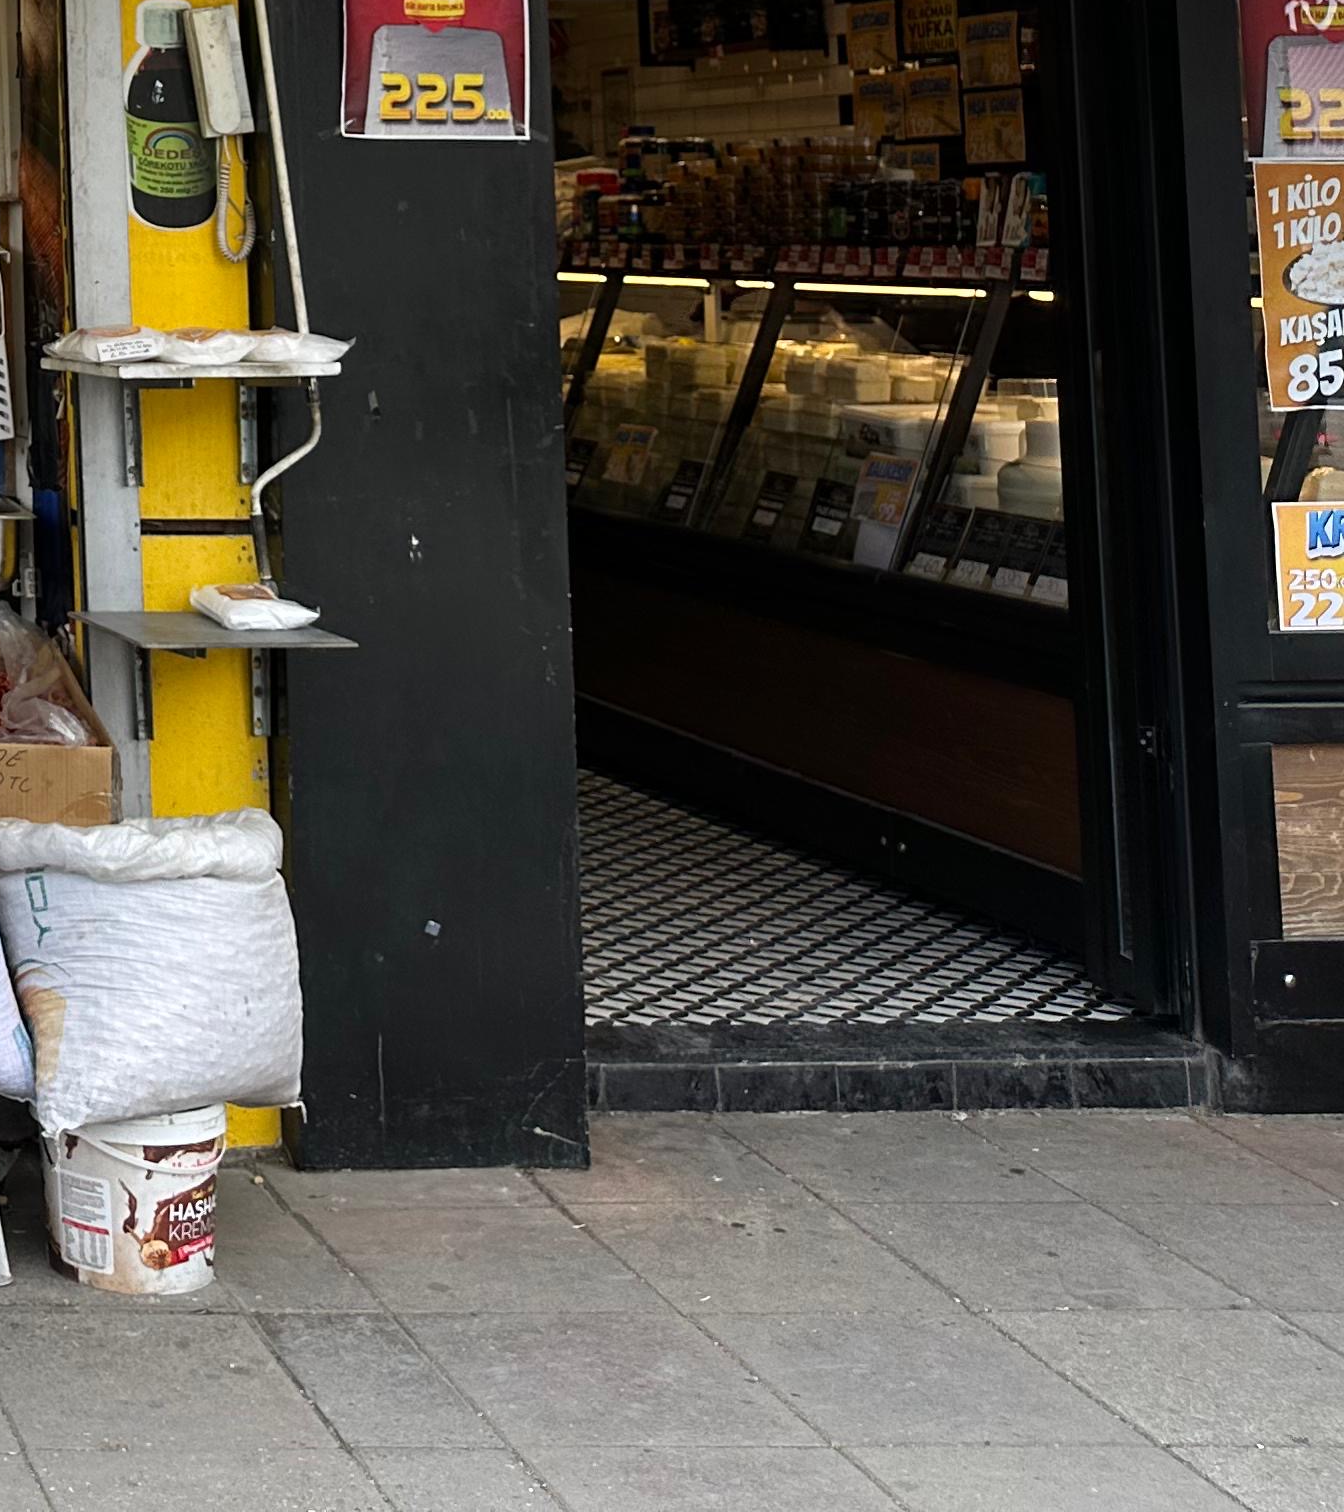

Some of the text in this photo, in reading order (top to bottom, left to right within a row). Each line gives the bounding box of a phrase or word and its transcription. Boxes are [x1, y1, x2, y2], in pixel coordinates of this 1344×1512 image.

[1268, 174, 1341, 215] 1 KİLO
[1273, 209, 1342, 249] 1 KİLO
